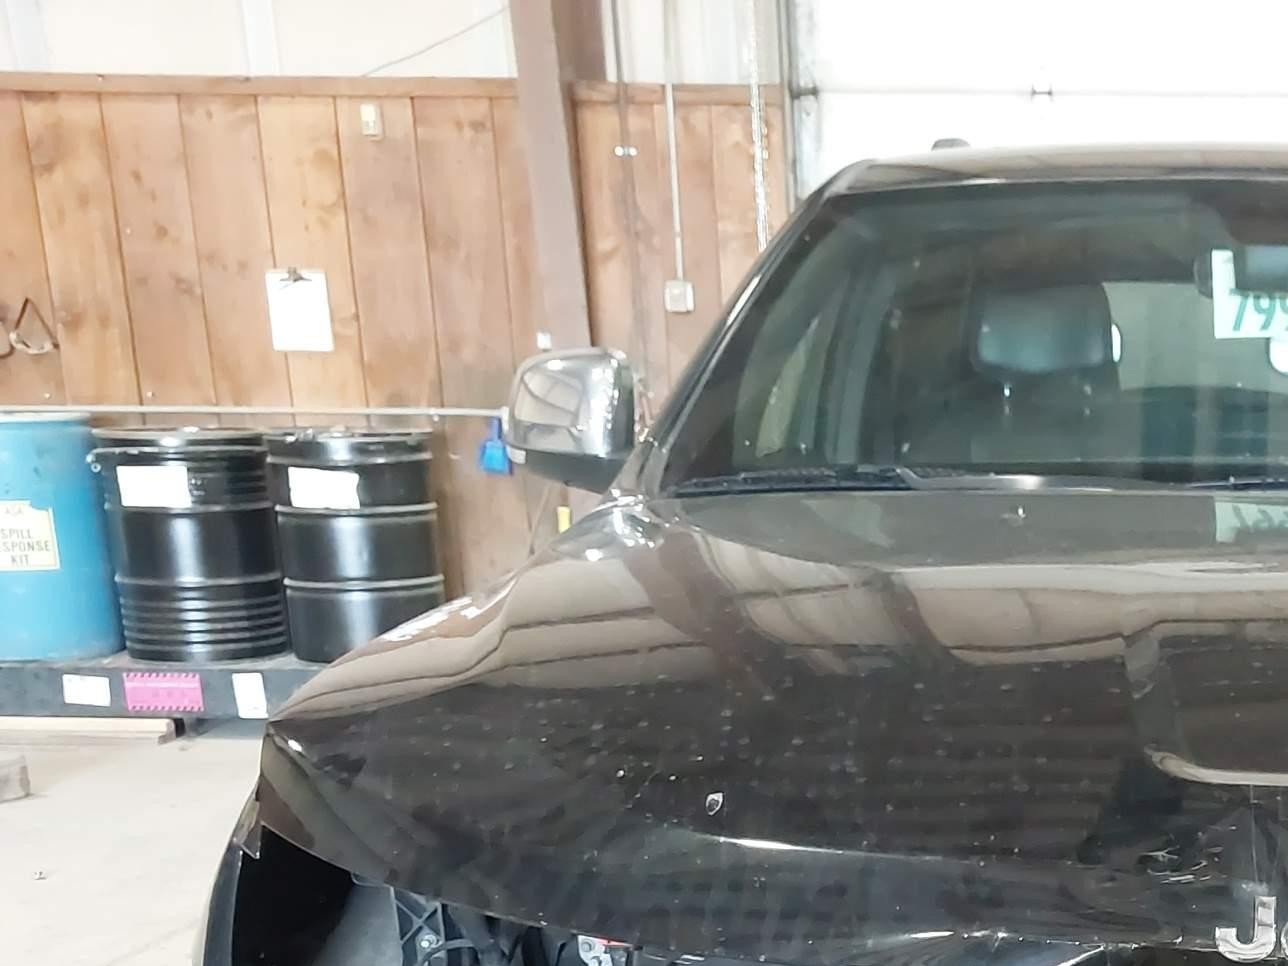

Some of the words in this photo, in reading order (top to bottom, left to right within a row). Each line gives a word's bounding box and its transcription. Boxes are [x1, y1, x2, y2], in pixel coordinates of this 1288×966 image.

[1, 528, 32, 539] SPILL
[0, 541, 50, 552] SPONSE
[11, 554, 30, 567] KIT
